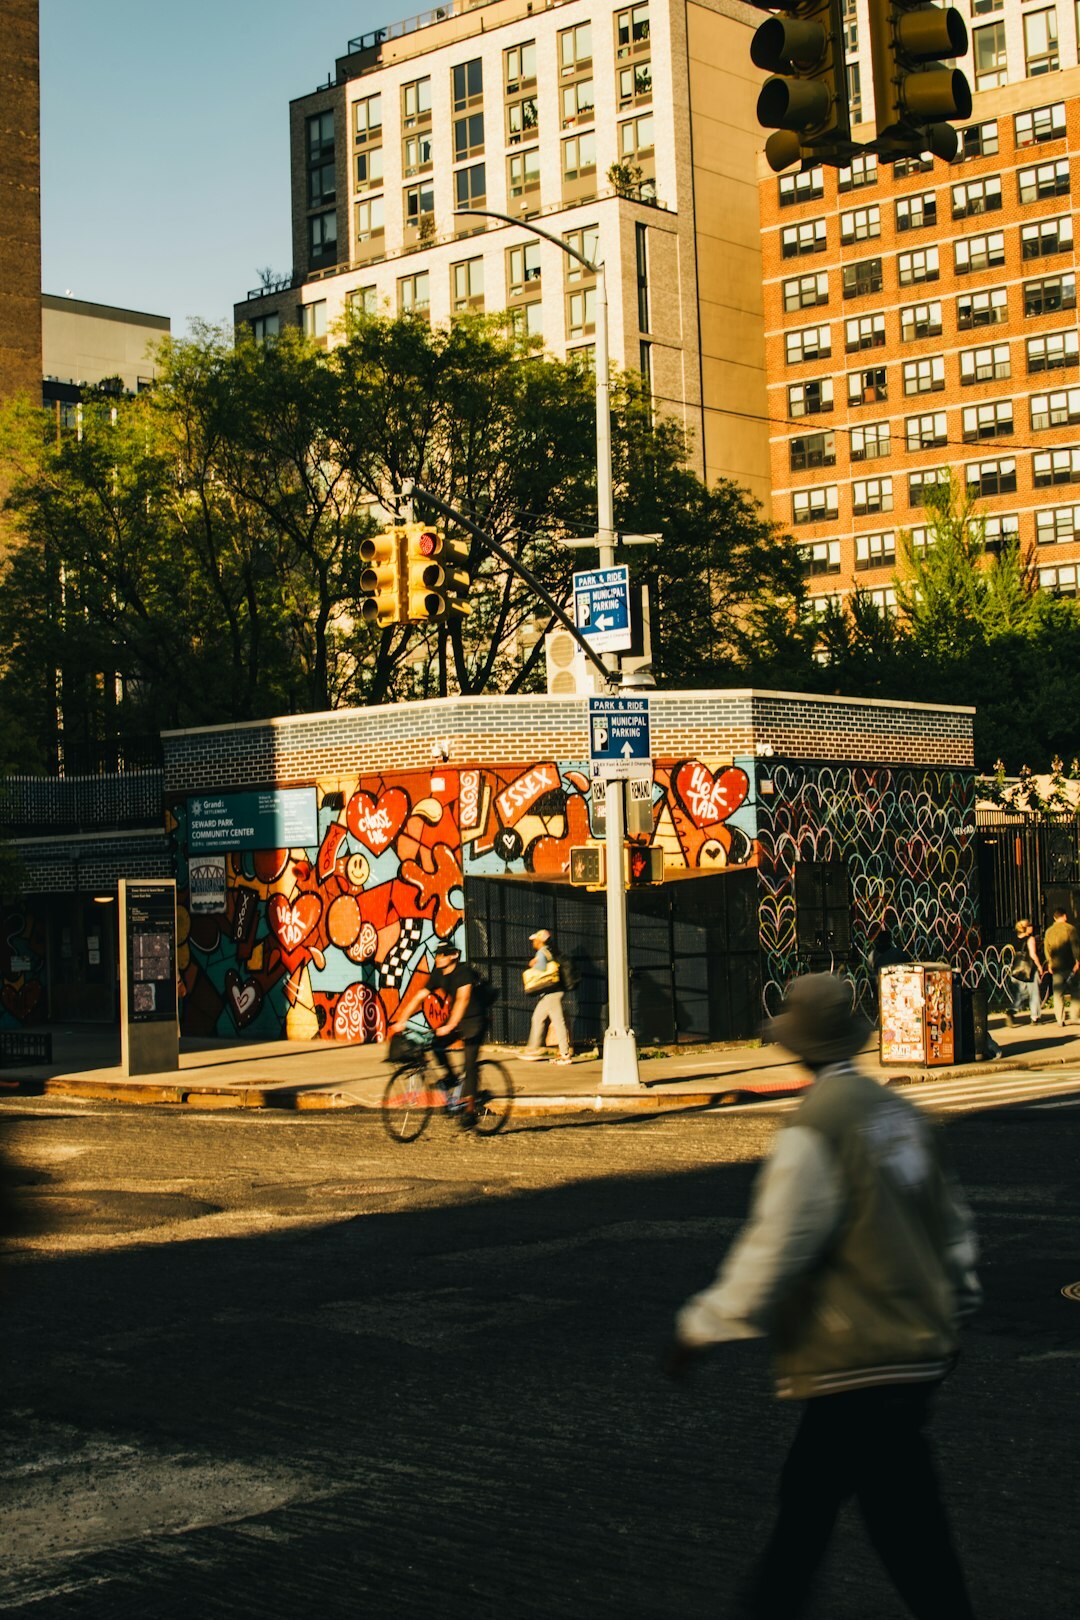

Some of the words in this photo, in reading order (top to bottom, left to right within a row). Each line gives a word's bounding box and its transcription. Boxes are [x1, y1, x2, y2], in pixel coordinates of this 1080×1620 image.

[579, 575, 596, 586] PARK
[599, 574, 605, 583] &
[606, 571, 622, 582] RIDE
[593, 587, 625, 601] MUNICIPAL
[593, 599, 619, 612] PARKING
[594, 702, 615, 710] PARK
[618, 702, 624, 710] &
[627, 702, 644, 710] RIDE
[611, 716, 646, 726] MUNICIPAL
[612, 728, 640, 737] PARKING
[594, 729, 608, 751] P
[500, 768, 552, 818] ESSEX
[191, 820, 216, 829] SEWARD
[217, 819, 234, 827] PARK
[191, 829, 229, 839] COMMUNITY
[230, 828, 254, 837] CENTER
[237, 894, 249, 938] XOXO
[278, 925, 303, 946] TAD
